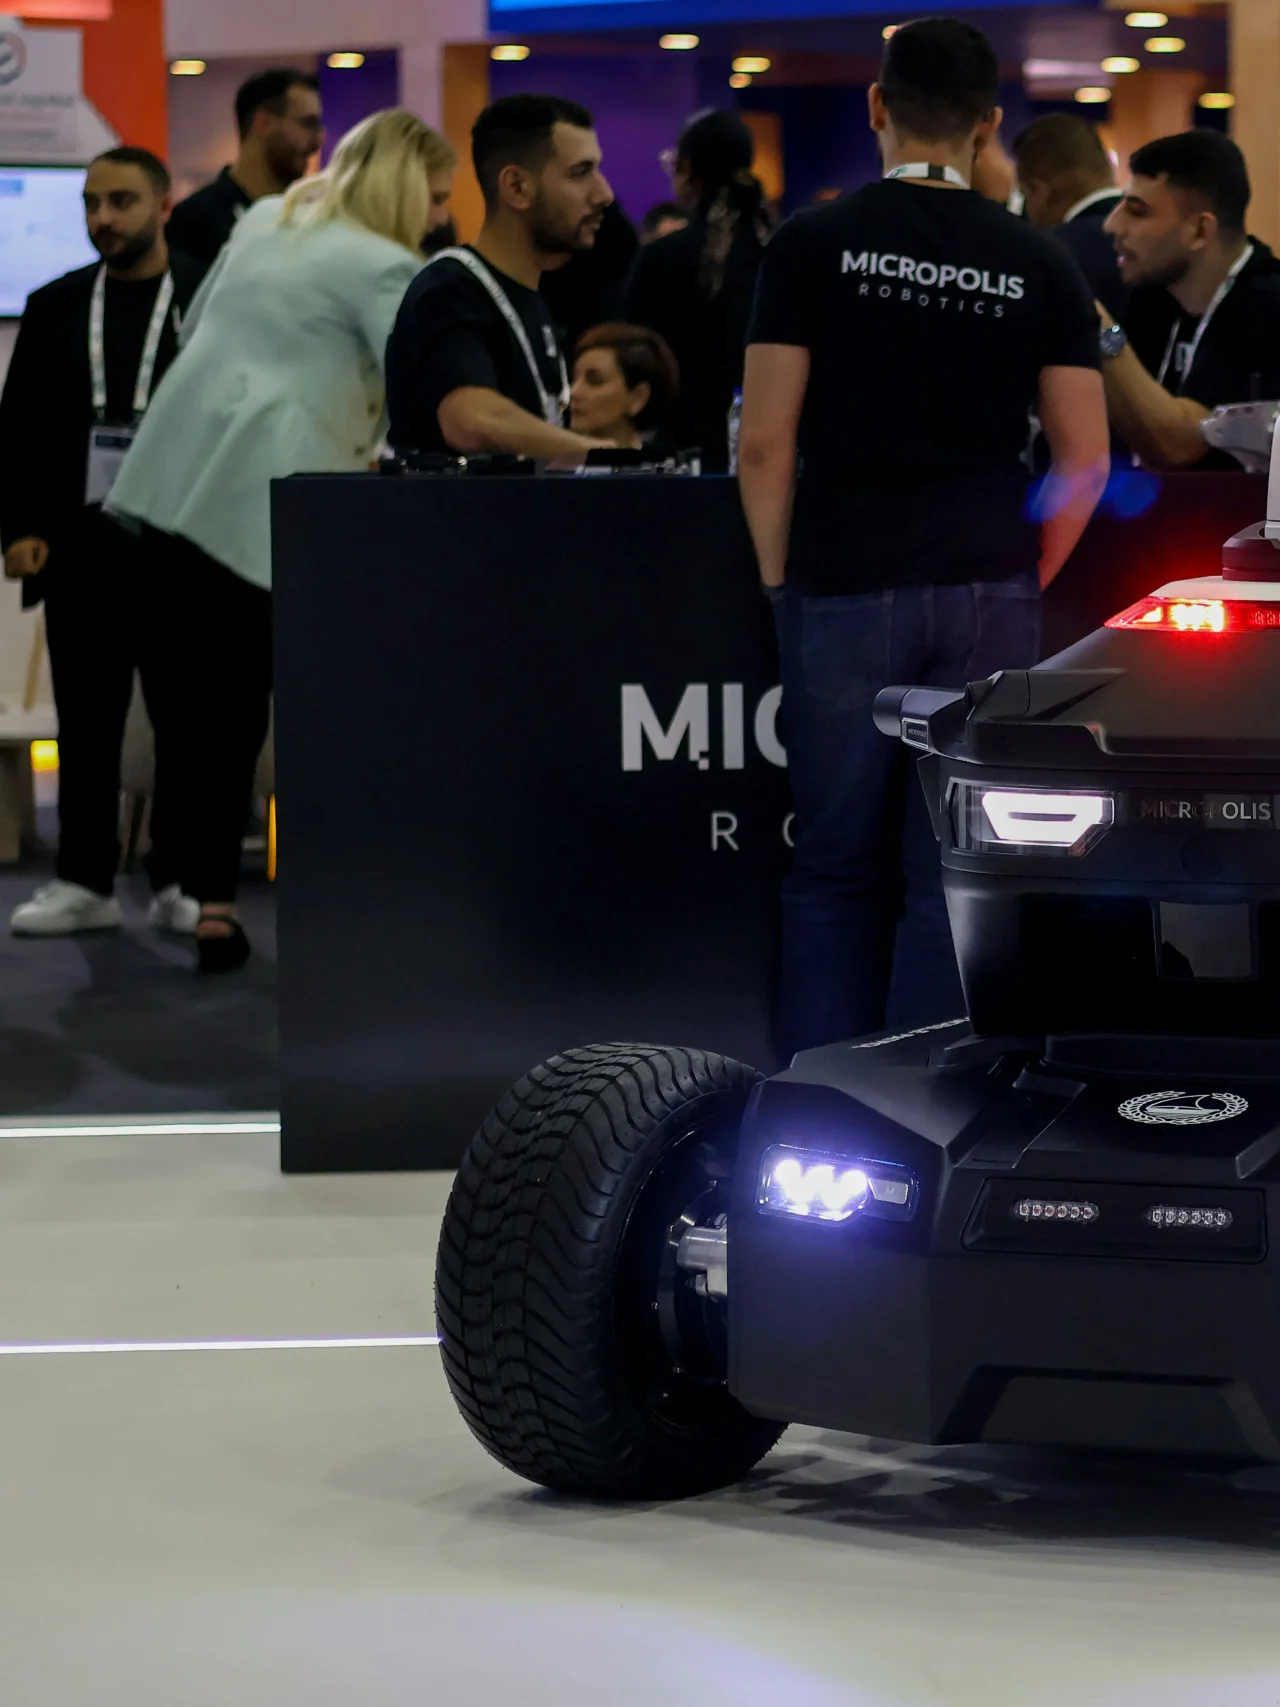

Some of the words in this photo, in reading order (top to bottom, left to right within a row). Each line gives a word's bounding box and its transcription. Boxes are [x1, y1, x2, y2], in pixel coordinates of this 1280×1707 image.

[841, 249, 1025, 300] MICROPOLIS
[858, 281, 1004, 318] ROBOTICS
[621, 683, 788, 772] MIC
